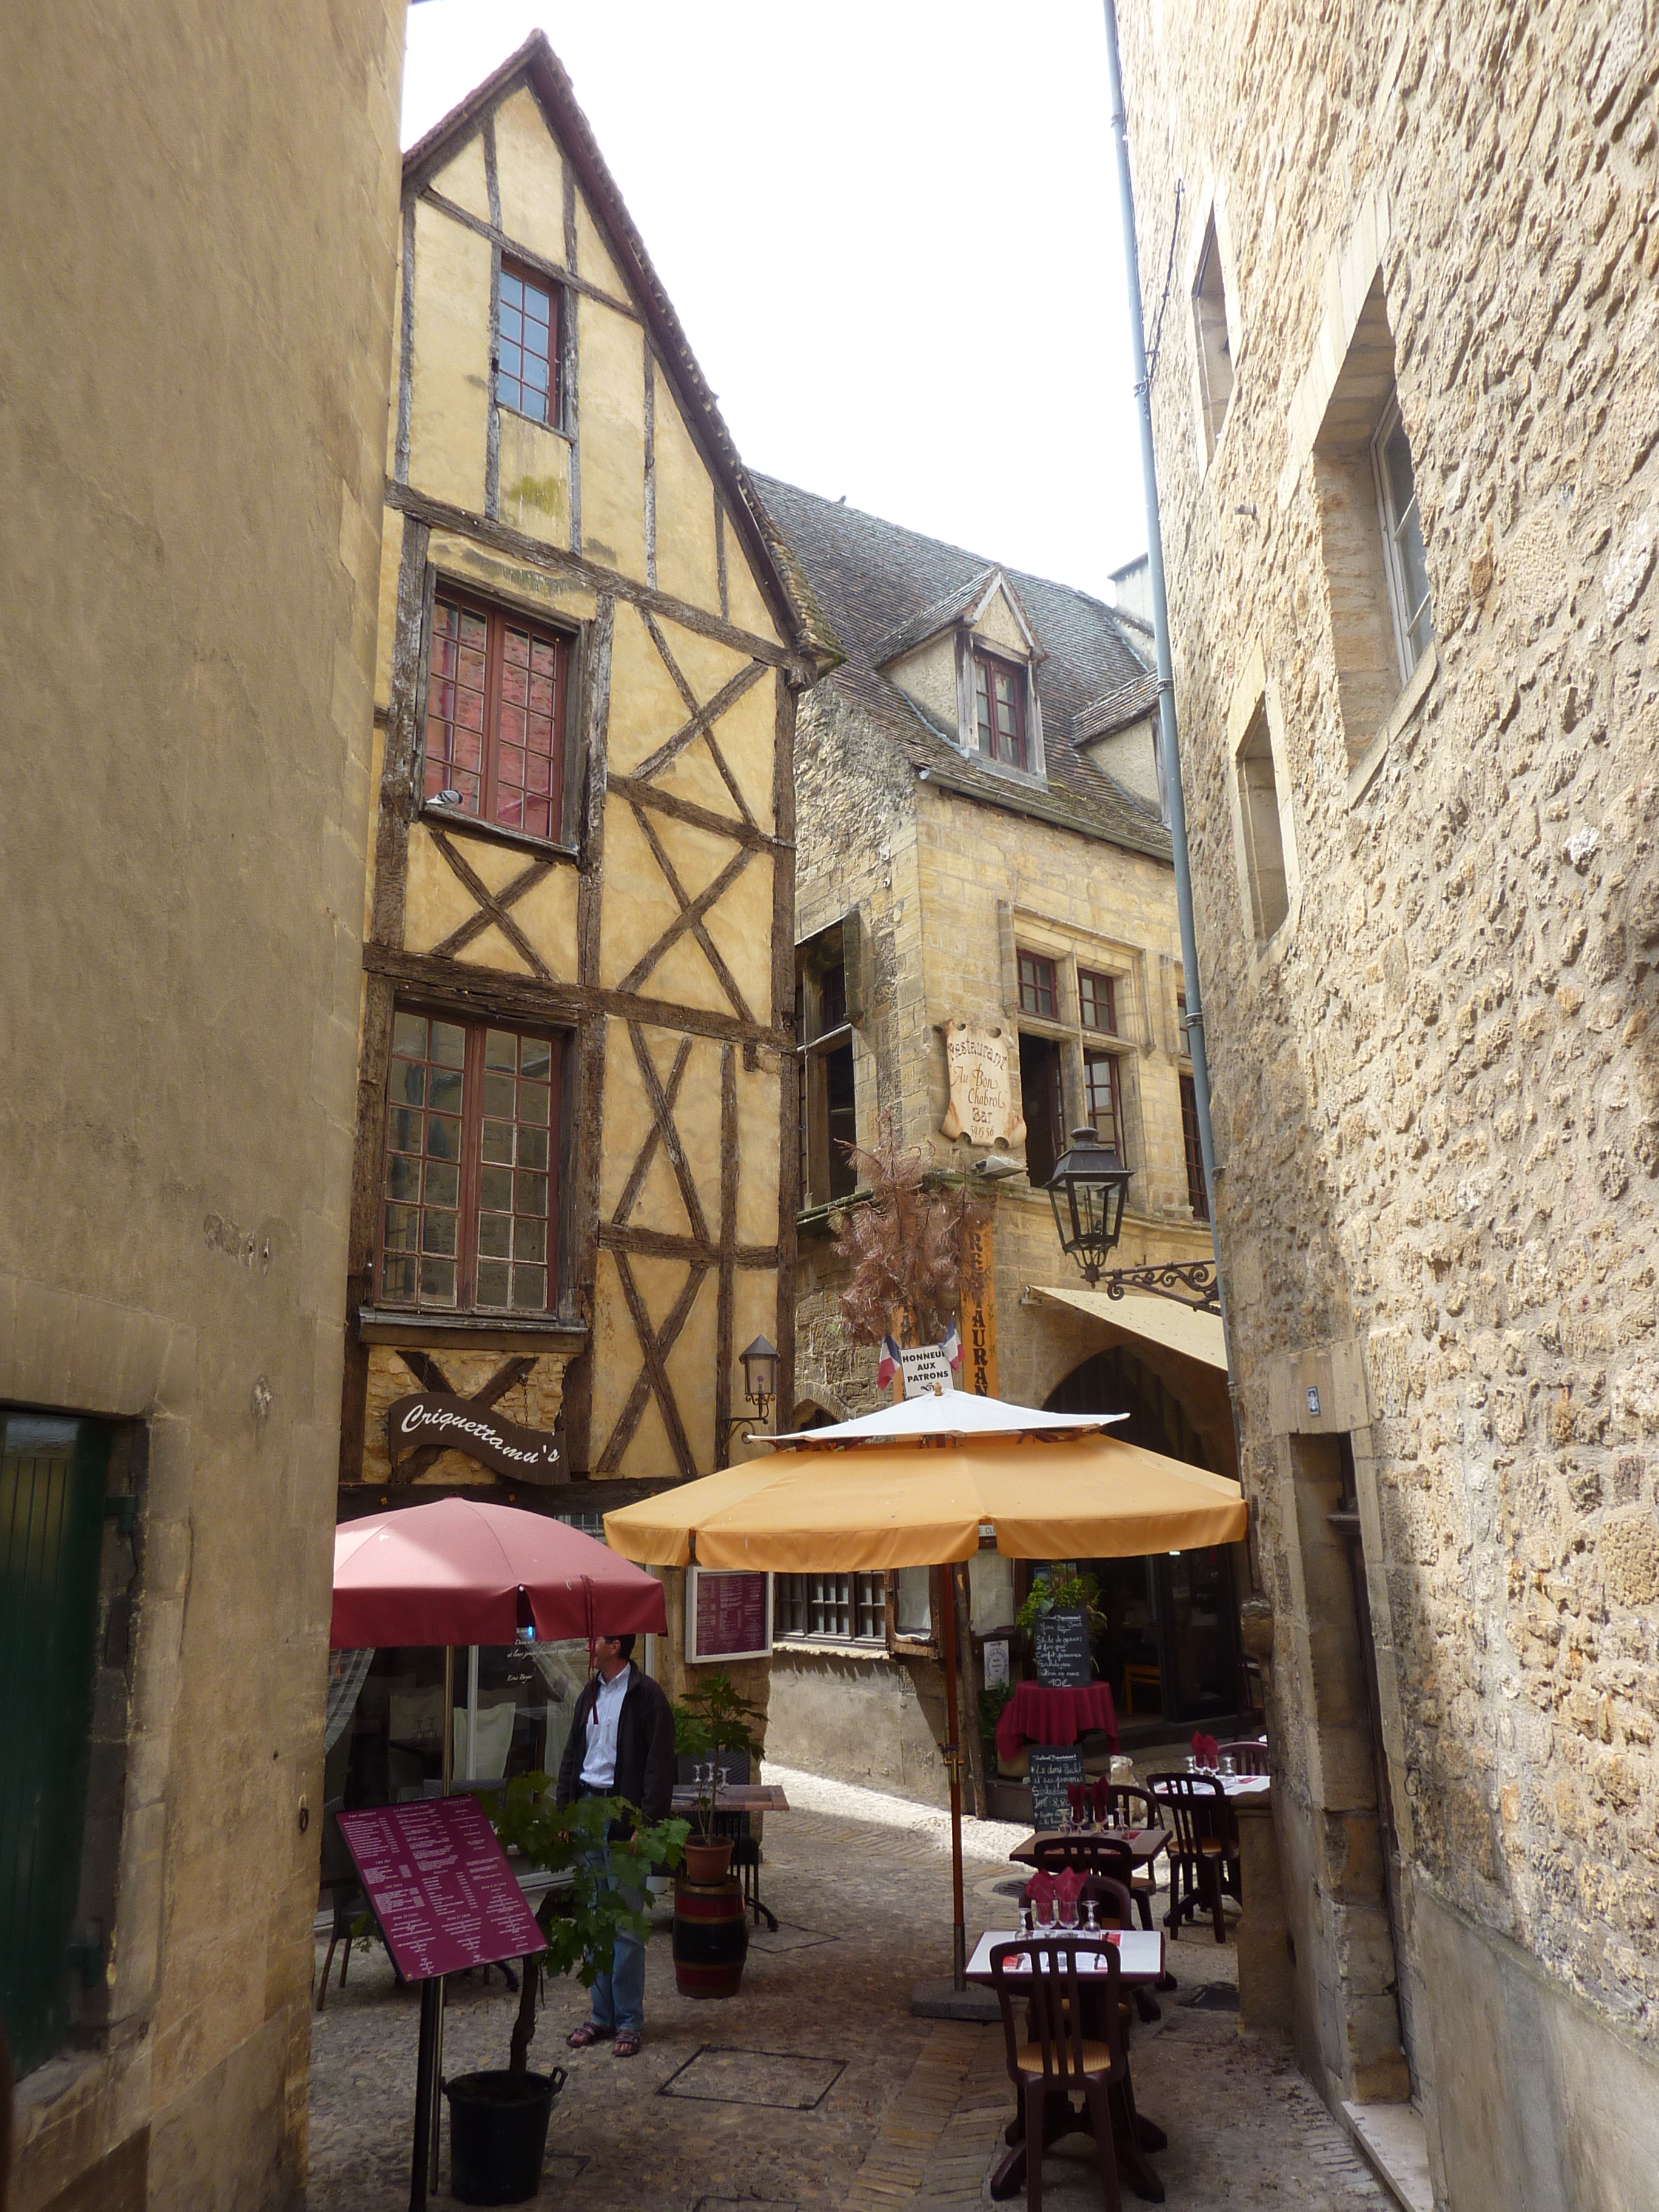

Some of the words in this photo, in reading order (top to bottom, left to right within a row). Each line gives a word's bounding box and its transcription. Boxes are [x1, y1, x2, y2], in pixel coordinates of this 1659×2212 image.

[948, 1037, 1007, 1070] Restaurant
[973, 1063, 999, 1089] Bon
[968, 1088, 1005, 1108] Chabrol
[972, 1107, 993, 1124] Bar
[969, 1232, 988, 1397] RESAURAN
[907, 1370, 949, 1383] PATRONS
[917, 1362, 937, 1372] AUX
[401, 1404, 560, 1464] Criquettamu's
[1048, 1678, 1072, 1687] 10€
